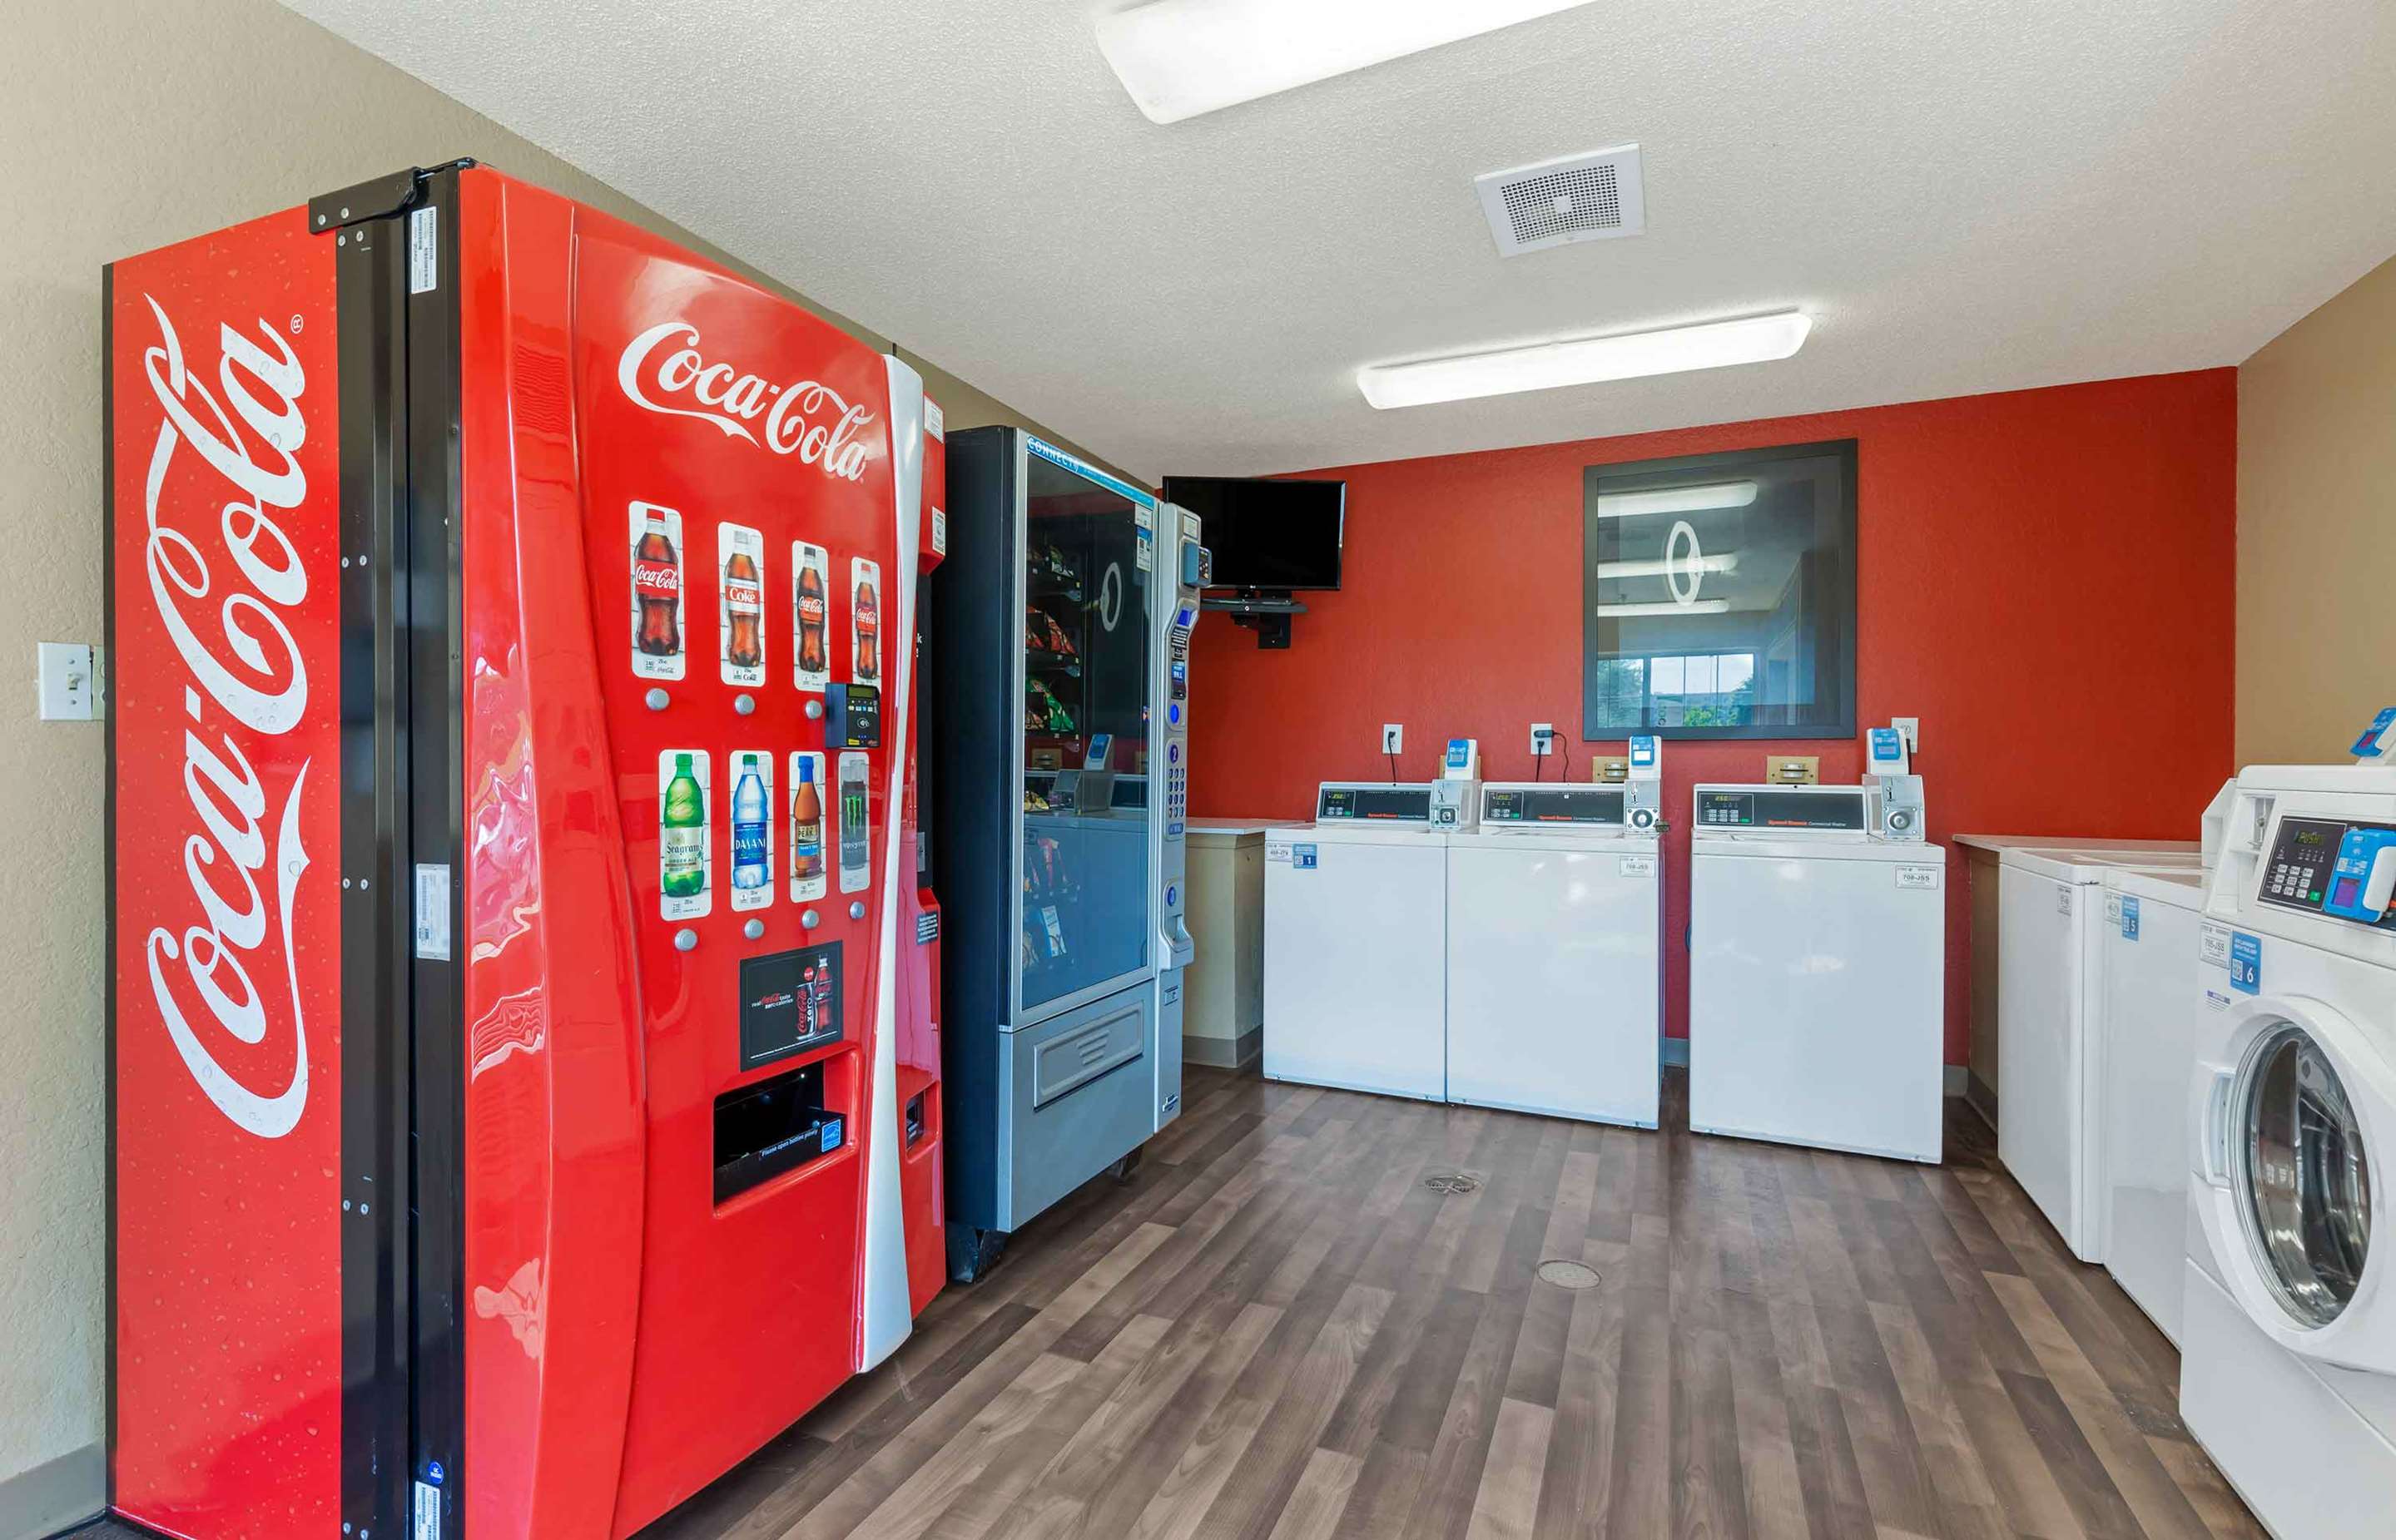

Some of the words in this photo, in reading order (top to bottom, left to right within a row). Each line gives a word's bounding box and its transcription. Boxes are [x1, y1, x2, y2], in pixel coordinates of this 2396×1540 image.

[618, 322, 876, 482] Coca-Cola
[636, 564, 678, 589] Coca-Cola
[730, 587, 756, 603] Coke
[798, 596, 823, 613] Coca-Cola
[145, 294, 310, 1138] Coca-Cola
[735, 838, 766, 849] DASANI
[2247, 967, 2254, 983] 6
